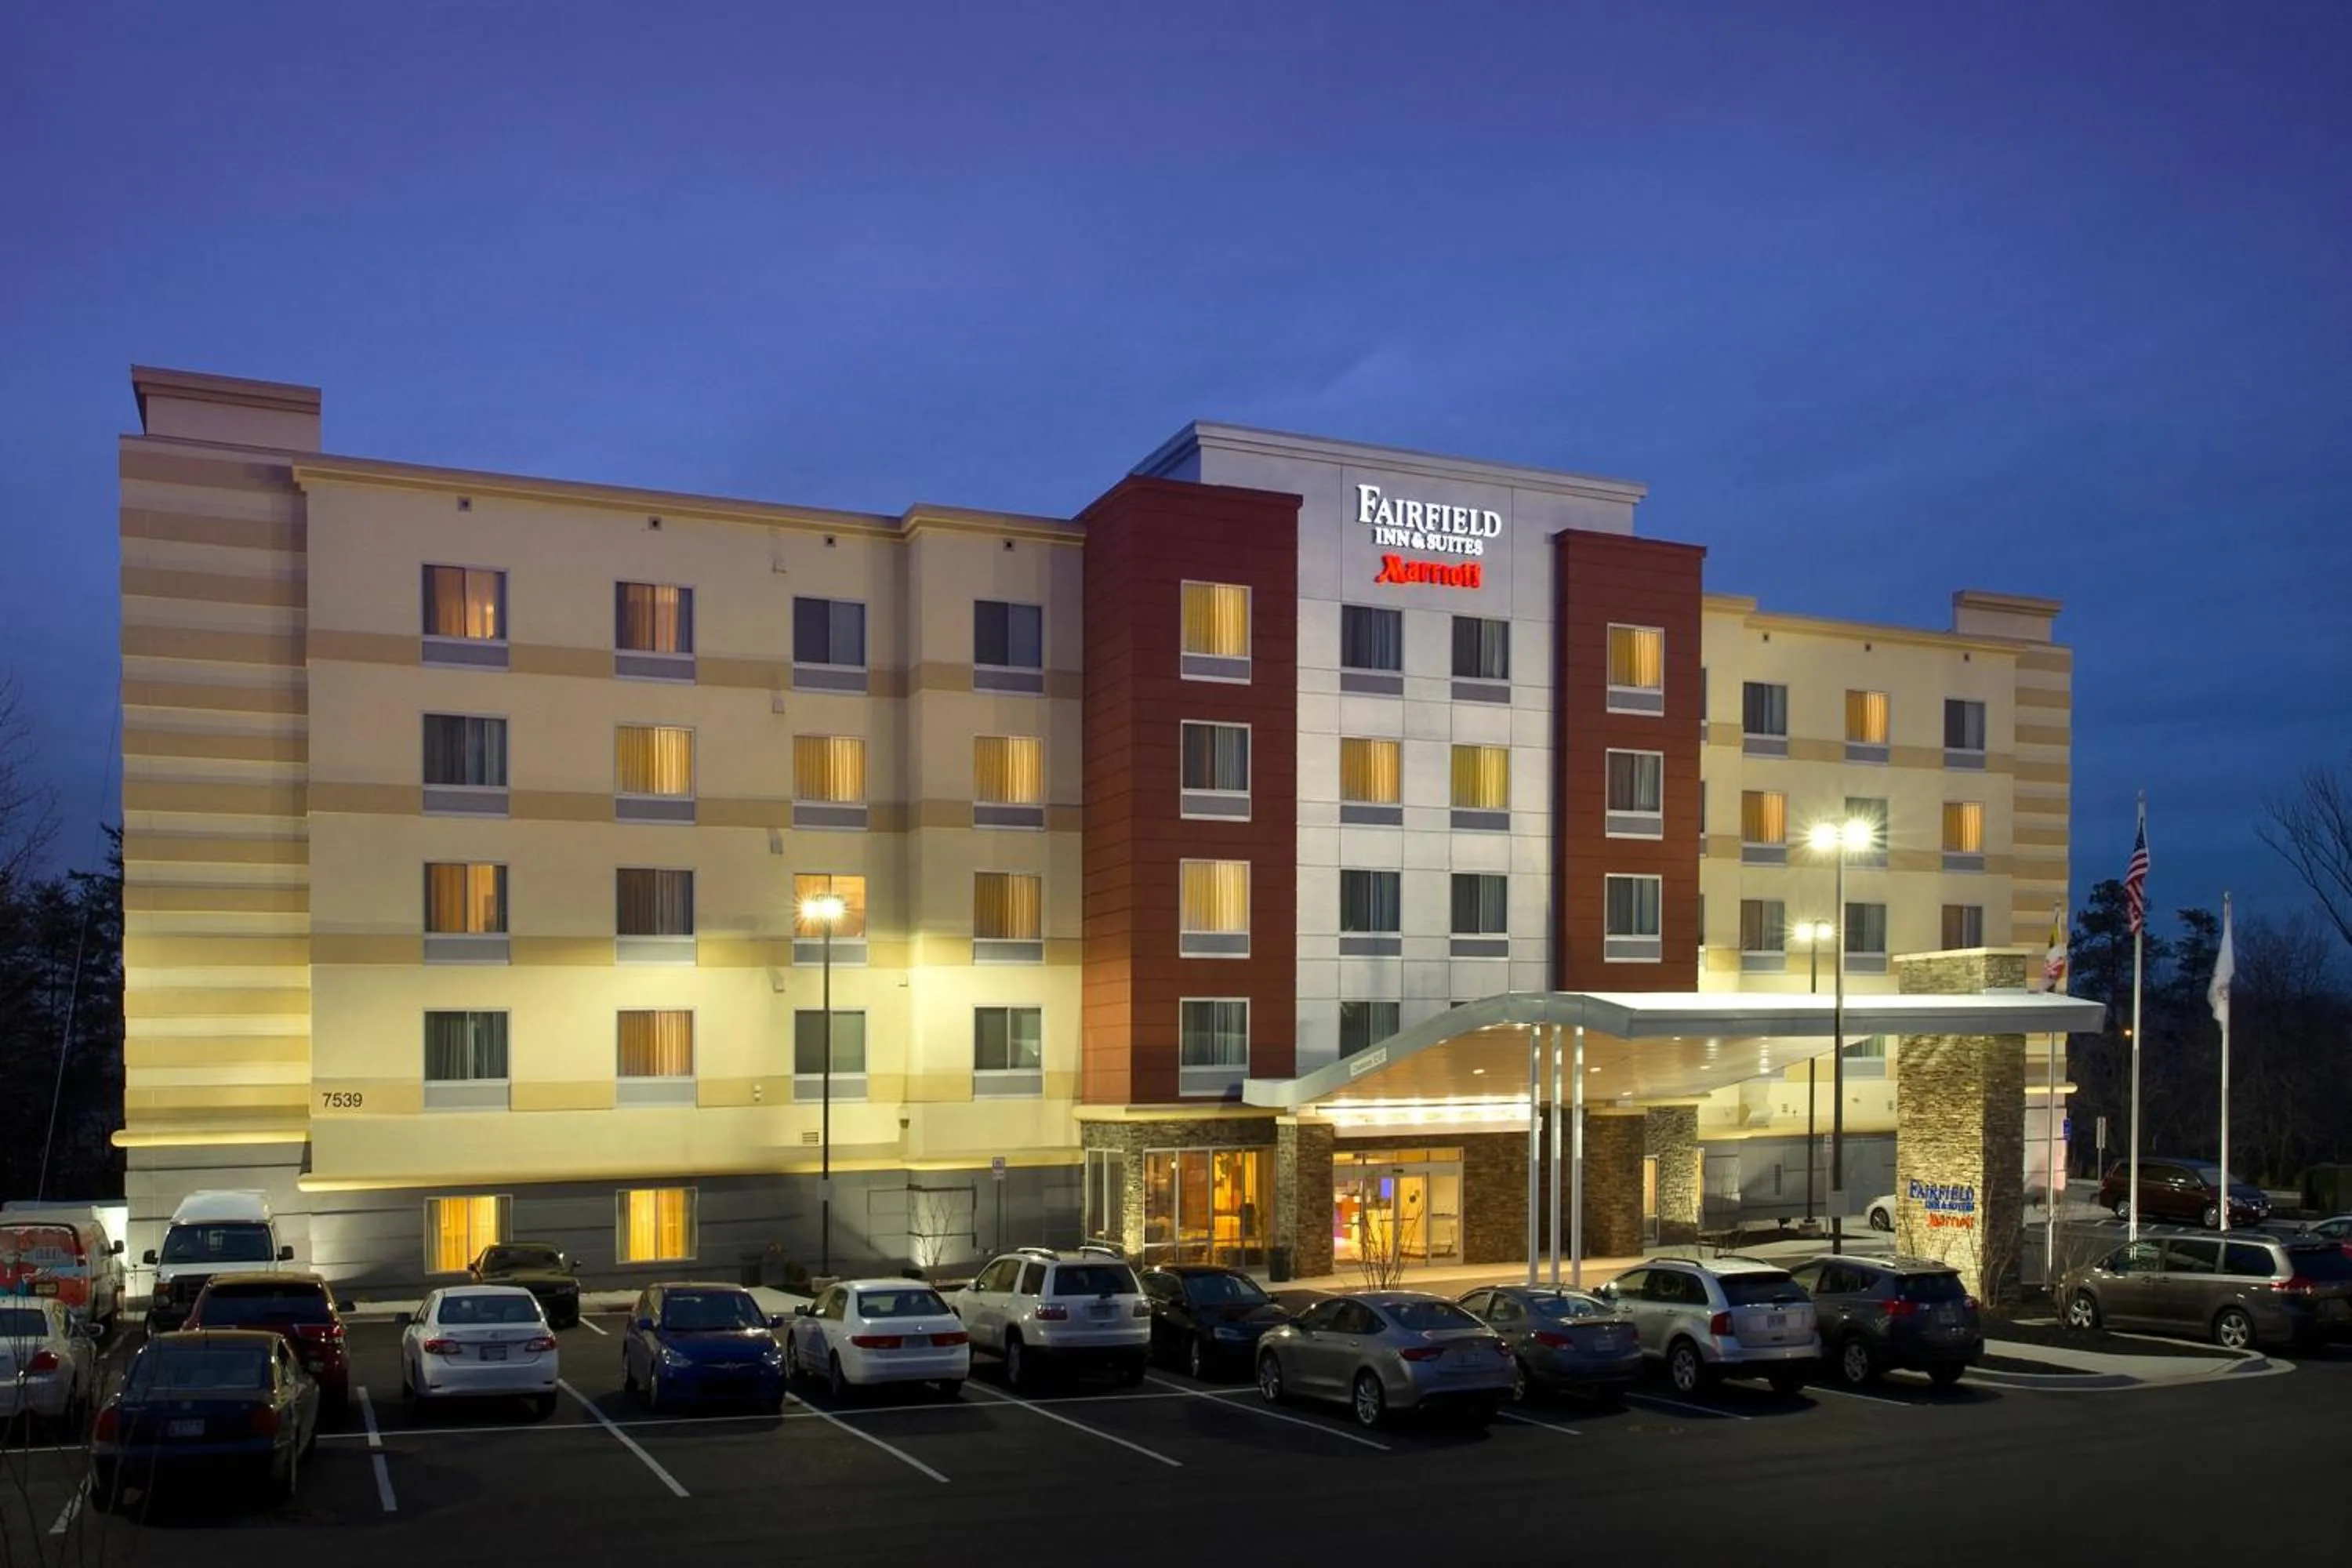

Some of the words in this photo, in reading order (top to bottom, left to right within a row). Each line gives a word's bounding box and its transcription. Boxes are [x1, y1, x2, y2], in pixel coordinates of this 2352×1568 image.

[1357, 484, 1502, 538] FAIRFIELD
[1374, 526, 1410, 548] INN
[1410, 532, 1425, 549] &
[1426, 534, 1483, 556] SUITES
[1375, 552, 1481, 588] Marriott
[321, 1092, 363, 1108] 7539
